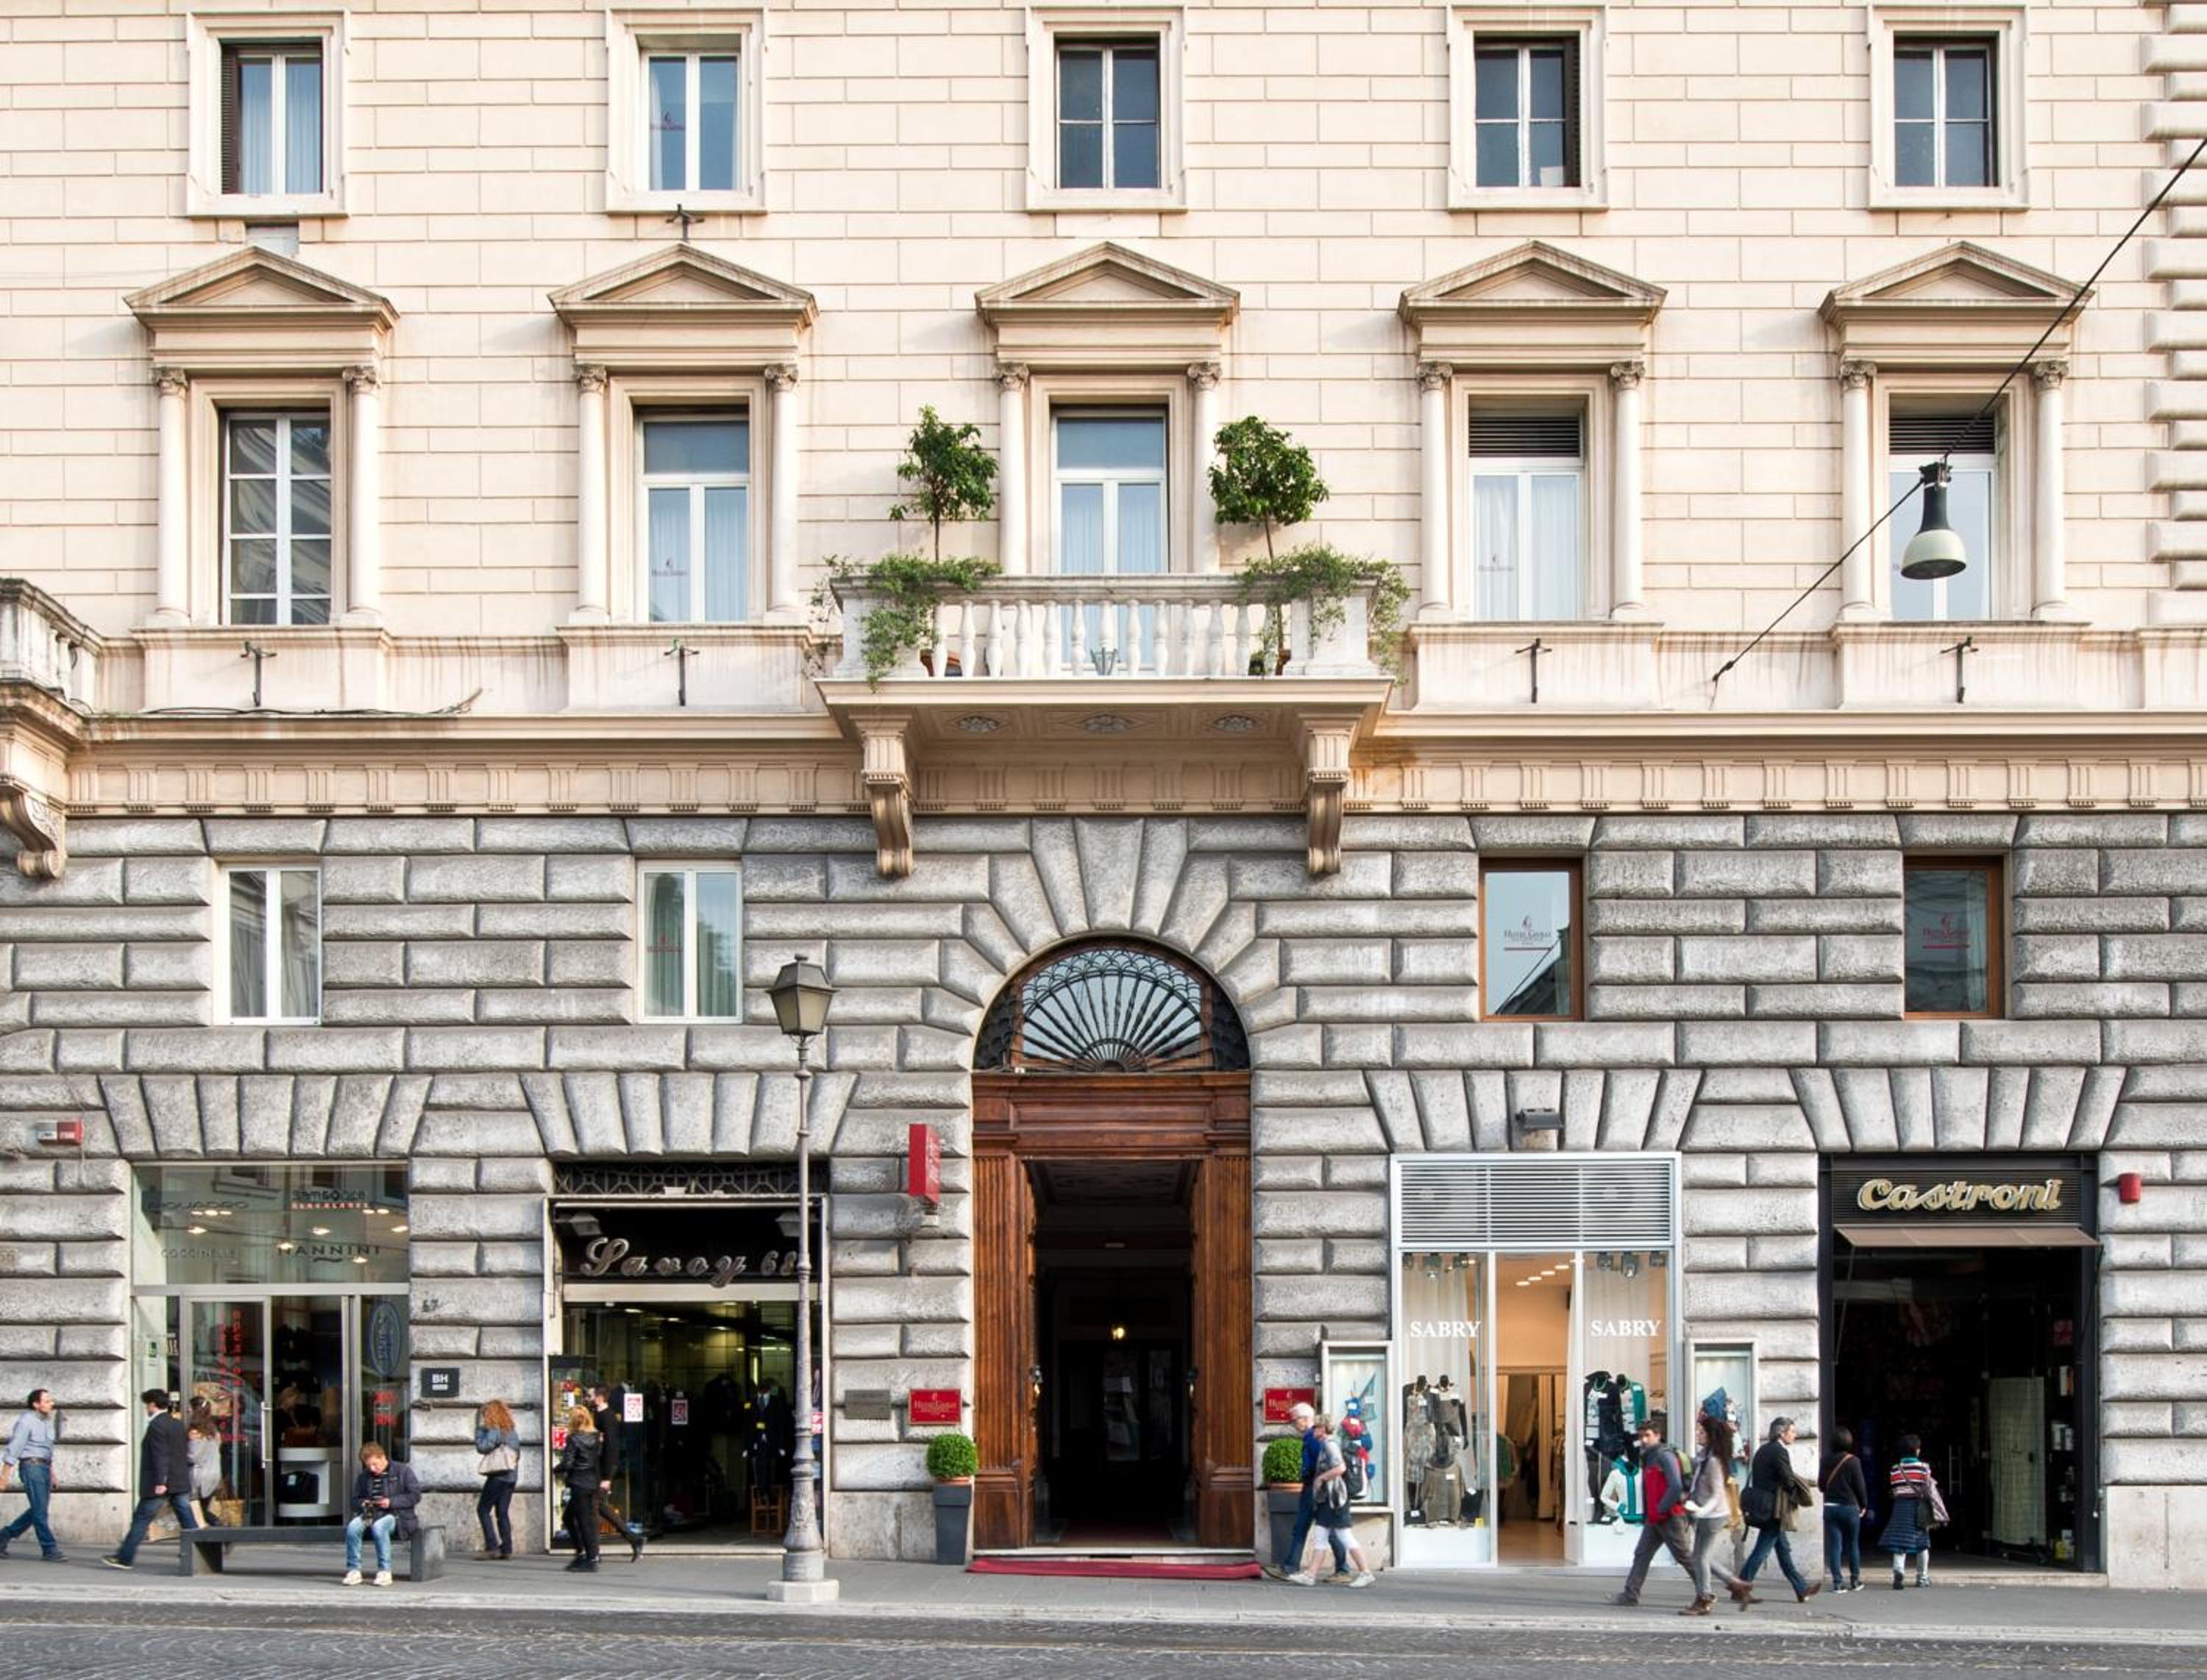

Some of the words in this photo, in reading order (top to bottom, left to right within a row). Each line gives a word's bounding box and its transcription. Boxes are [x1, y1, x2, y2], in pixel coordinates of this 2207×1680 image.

[1858, 1178, 2063, 1210] Castroni
[161, 1247, 237, 1259] COCCINELLE
[580, 1237, 747, 1289] Savoy
[1410, 1320, 1482, 1338] SABRY
[1590, 1320, 1661, 1337] SABRY
